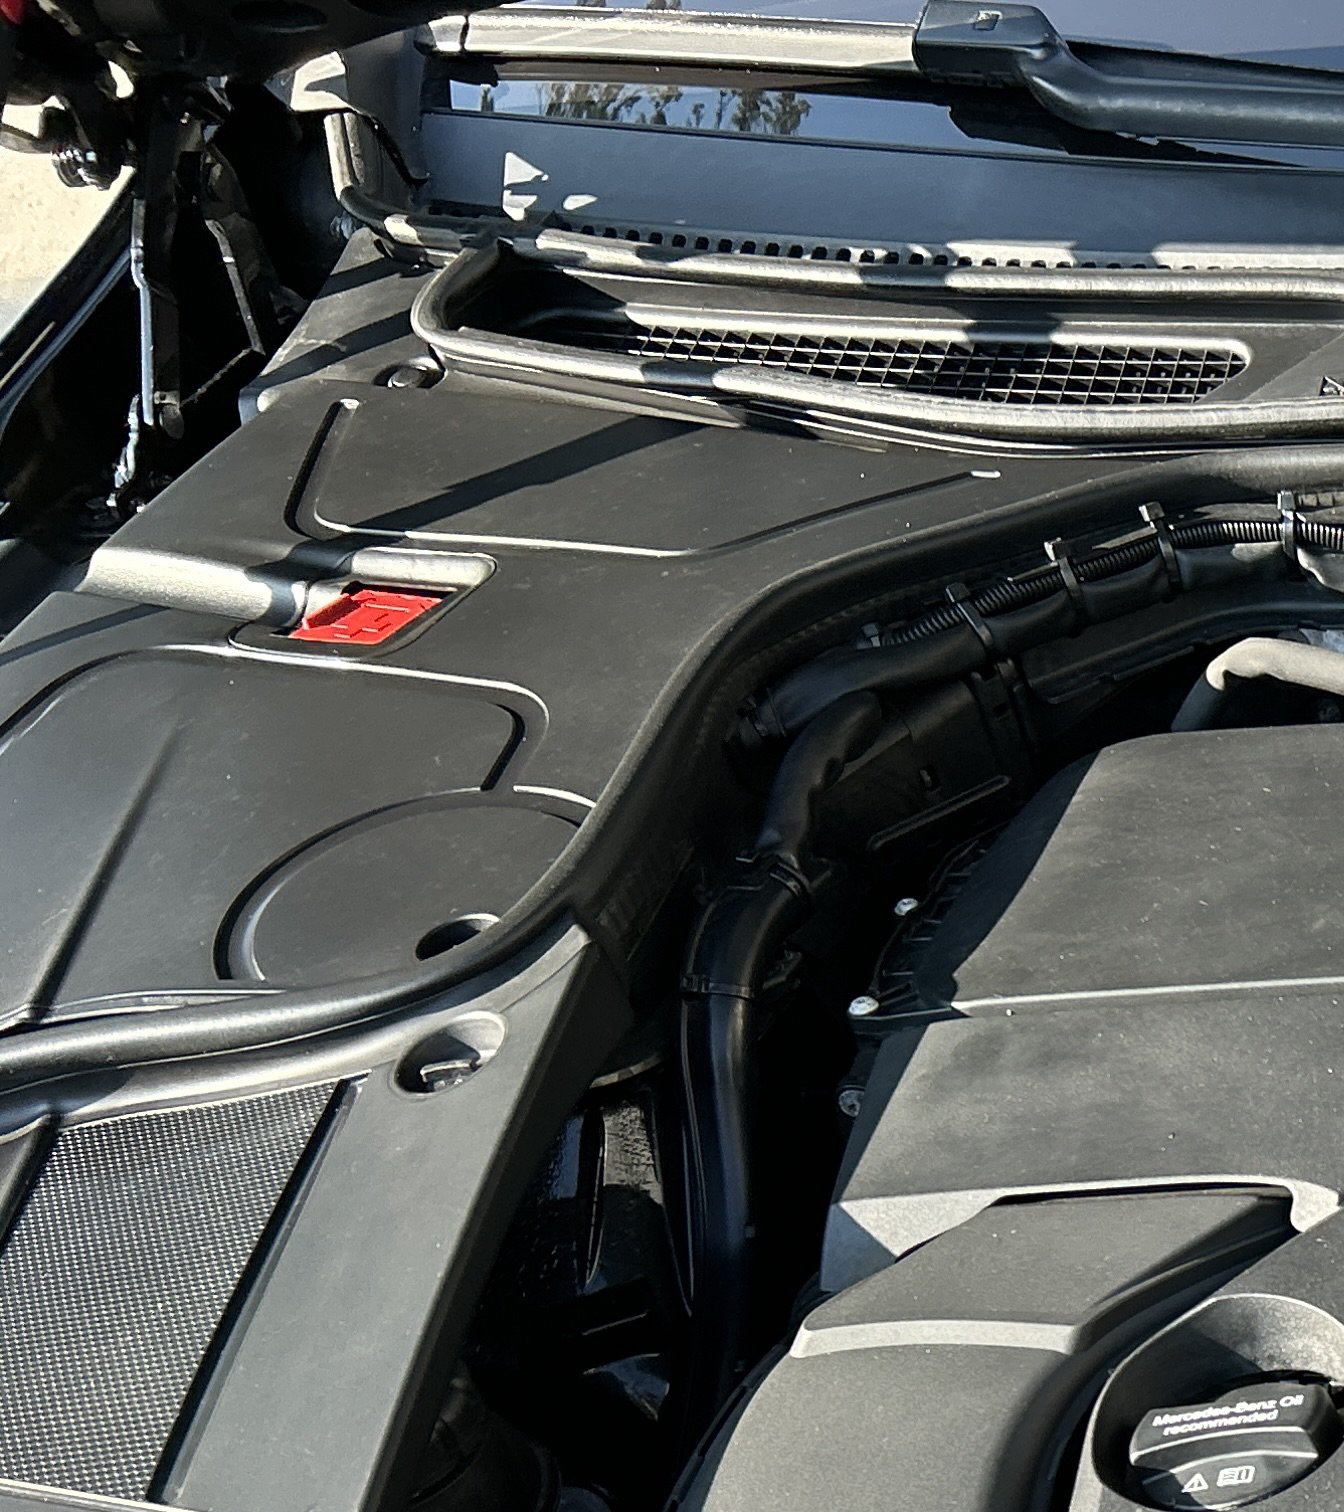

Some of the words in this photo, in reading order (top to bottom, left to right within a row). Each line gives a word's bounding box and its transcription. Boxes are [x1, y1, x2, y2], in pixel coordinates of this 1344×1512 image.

[1152, 1400, 1278, 1427] Mercedes-Benz
[1279, 1394, 1305, 1408] Oil
[1162, 1409, 1279, 1436] recommended
